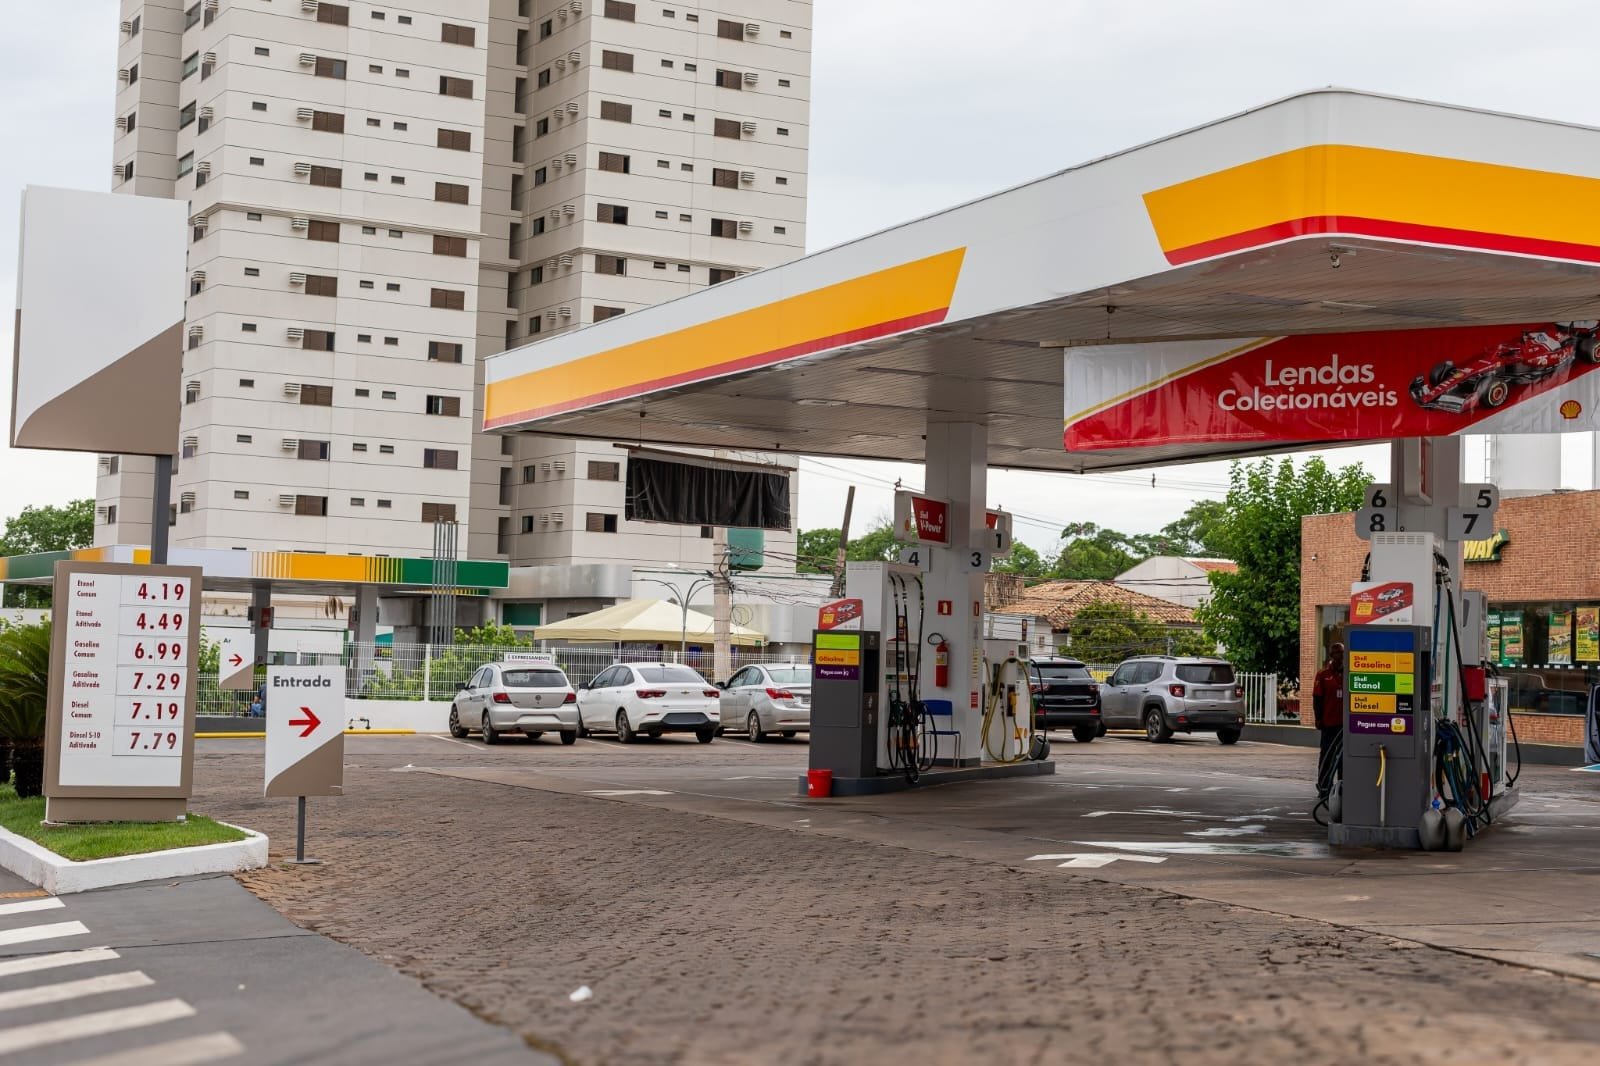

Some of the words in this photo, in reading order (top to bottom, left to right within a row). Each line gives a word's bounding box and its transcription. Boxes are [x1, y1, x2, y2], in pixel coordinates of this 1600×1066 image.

[1265, 354, 1375, 386] Lendas
[1217, 383, 1398, 411] Colecionáveis
[1371, 489, 1387, 508] 6
[1476, 489, 1492, 508] 5
[920, 520, 942, 533] V-Power
[1369, 513, 1385, 532] 8
[1462, 513, 1480, 534] 7
[995, 533, 1002, 548] 1
[908, 551, 919, 566] 4
[971, 551, 982, 567] 3
[137, 582, 184, 600] 4.19
[136, 613, 182, 630] 4.49
[134, 642, 181, 660] 6.99
[1353, 661, 1392, 669] Gasolina
[132, 672, 180, 690] 7.29
[273, 674, 331, 688] Entrada
[1353, 681, 1381, 690] Etanol
[131, 702, 178, 720] 7.19
[1354, 702, 1379, 710] Diesel
[69, 731, 88, 739] Diesel
[130, 732, 177, 750] 7.79
